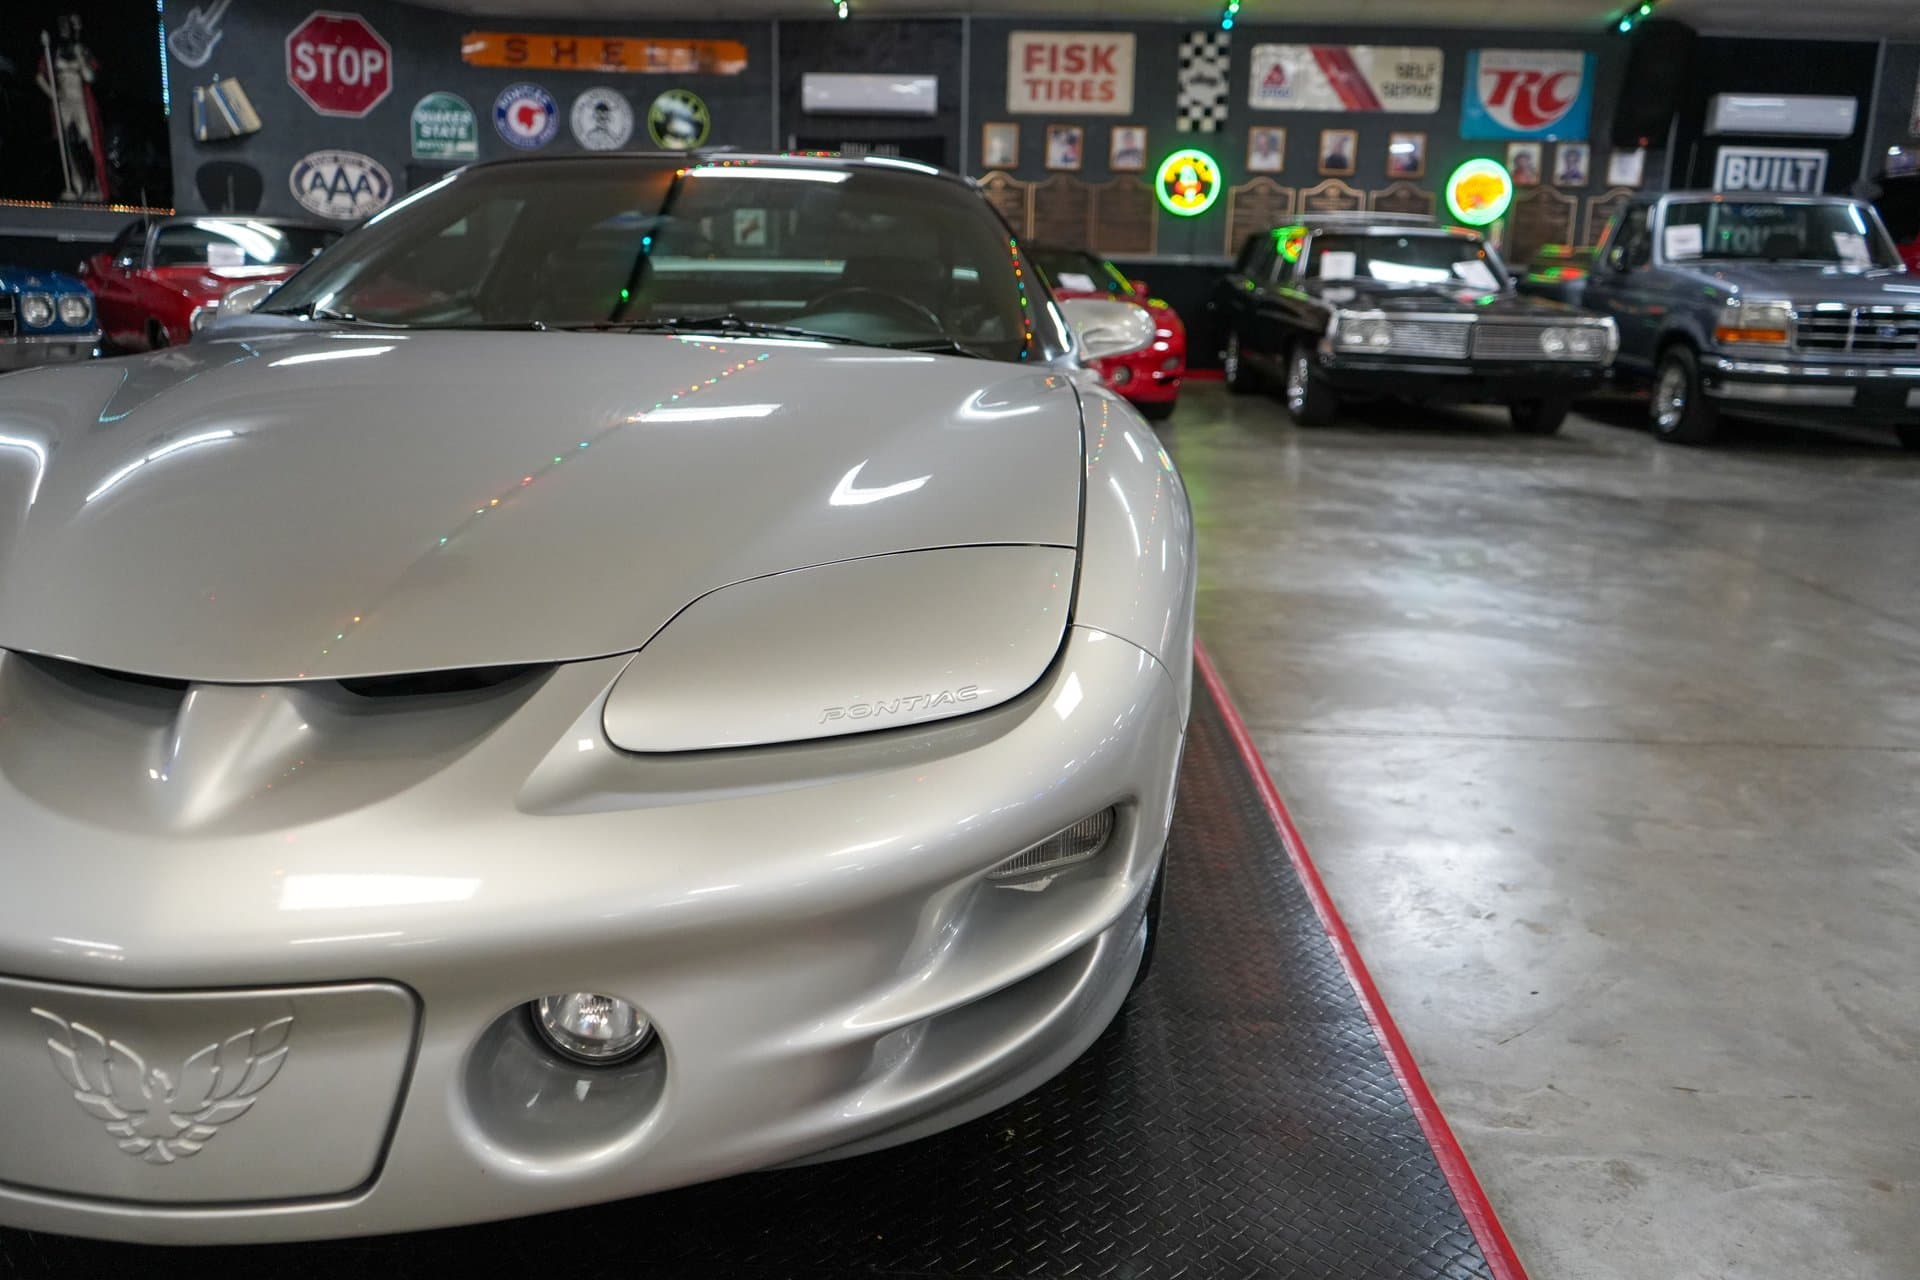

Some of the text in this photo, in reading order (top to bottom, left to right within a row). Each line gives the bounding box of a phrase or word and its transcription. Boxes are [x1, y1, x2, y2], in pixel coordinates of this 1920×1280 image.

[295, 41, 384, 87] STOP
[1023, 43, 1119, 75] FISK
[1025, 78, 1117, 102] TIRES
[1482, 68, 1580, 128] RC
[415, 111, 472, 123] QUAKER
[421, 124, 467, 139] STATE
[310, 166, 373, 205] AAA
[1724, 157, 1816, 192] BUILT
[818, 685, 979, 724] PONTIAC
